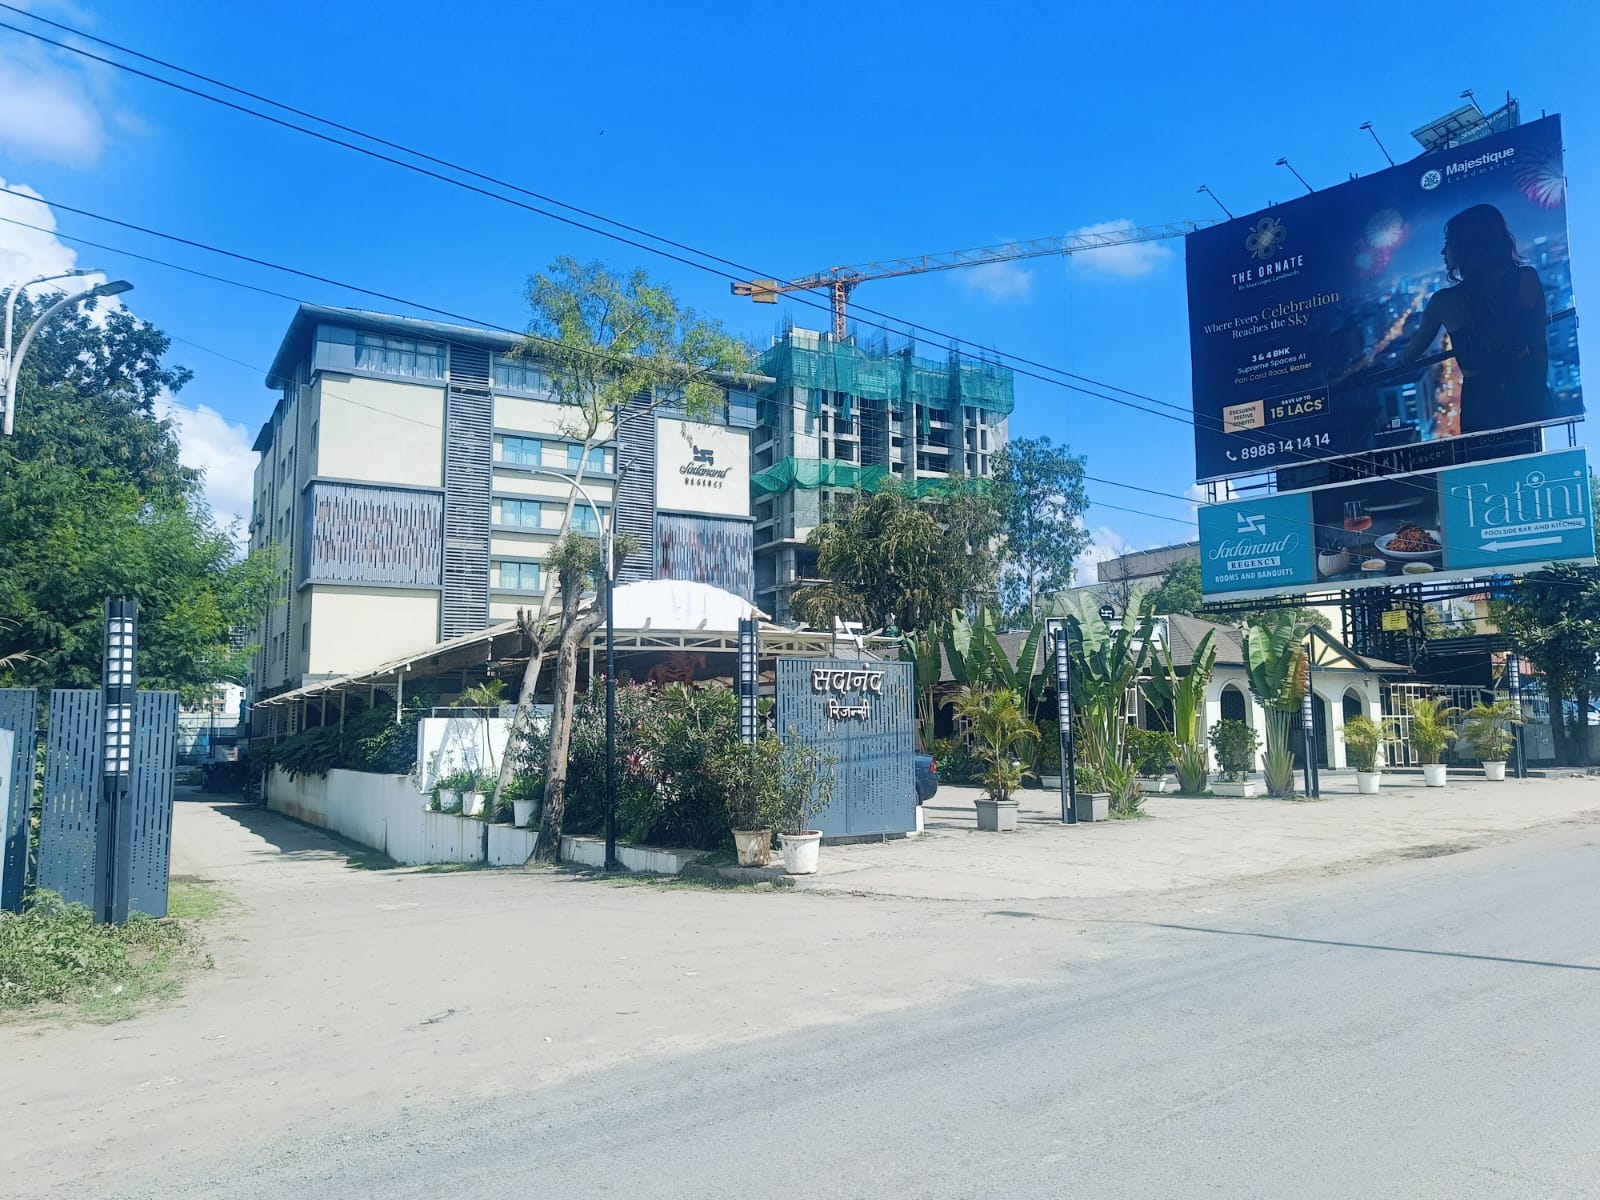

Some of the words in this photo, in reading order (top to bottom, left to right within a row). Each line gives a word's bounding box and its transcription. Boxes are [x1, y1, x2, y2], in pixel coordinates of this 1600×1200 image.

[1446, 147, 1514, 176] Majestique
[1232, 270, 1252, 285] THE
[1258, 254, 1304, 278] ORNATE
[1204, 321, 1232, 334] Where
[1234, 314, 1260, 327] Every
[1261, 292, 1340, 320] Celebration
[1232, 322, 1269, 340] Reaches
[1270, 318, 1286, 330] the
[1288, 312, 1310, 327] Sky
[1252, 354, 1257, 362] 3
[1273, 347, 1290, 358] BHK
[1234, 376, 1248, 384] Pan
[1250, 372, 1267, 381] Card
[1290, 362, 1312, 372] Baner
[1237, 362, 1269, 374] Supreme
[1270, 356, 1297, 367] Spaces
[1281, 398, 1295, 406] SAVE
[1234, 412, 1254, 420] FESTIVE
[1270, 406, 1284, 419] 15
[1241, 442, 1276, 460] 8988
[1278, 440, 1294, 453] 14
[1296, 436, 1312, 450] 14
[1314, 432, 1330, 446] 14
[679, 462, 733, 479] Sadanand
[1451, 470, 1584, 528] Tatini
[1484, 528, 1516, 536] POOLSIDE
[1551, 520, 1582, 528] KITCHEN
[1208, 532, 1299, 560] Sadanand
[1231, 557, 1277, 569] REGENCY
[1215, 574, 1239, 583] ROOMS
[1240, 572, 1256, 580] AND
[1257, 568, 1294, 578] BANQUETS
[813, 662, 886, 695] सदानंद
